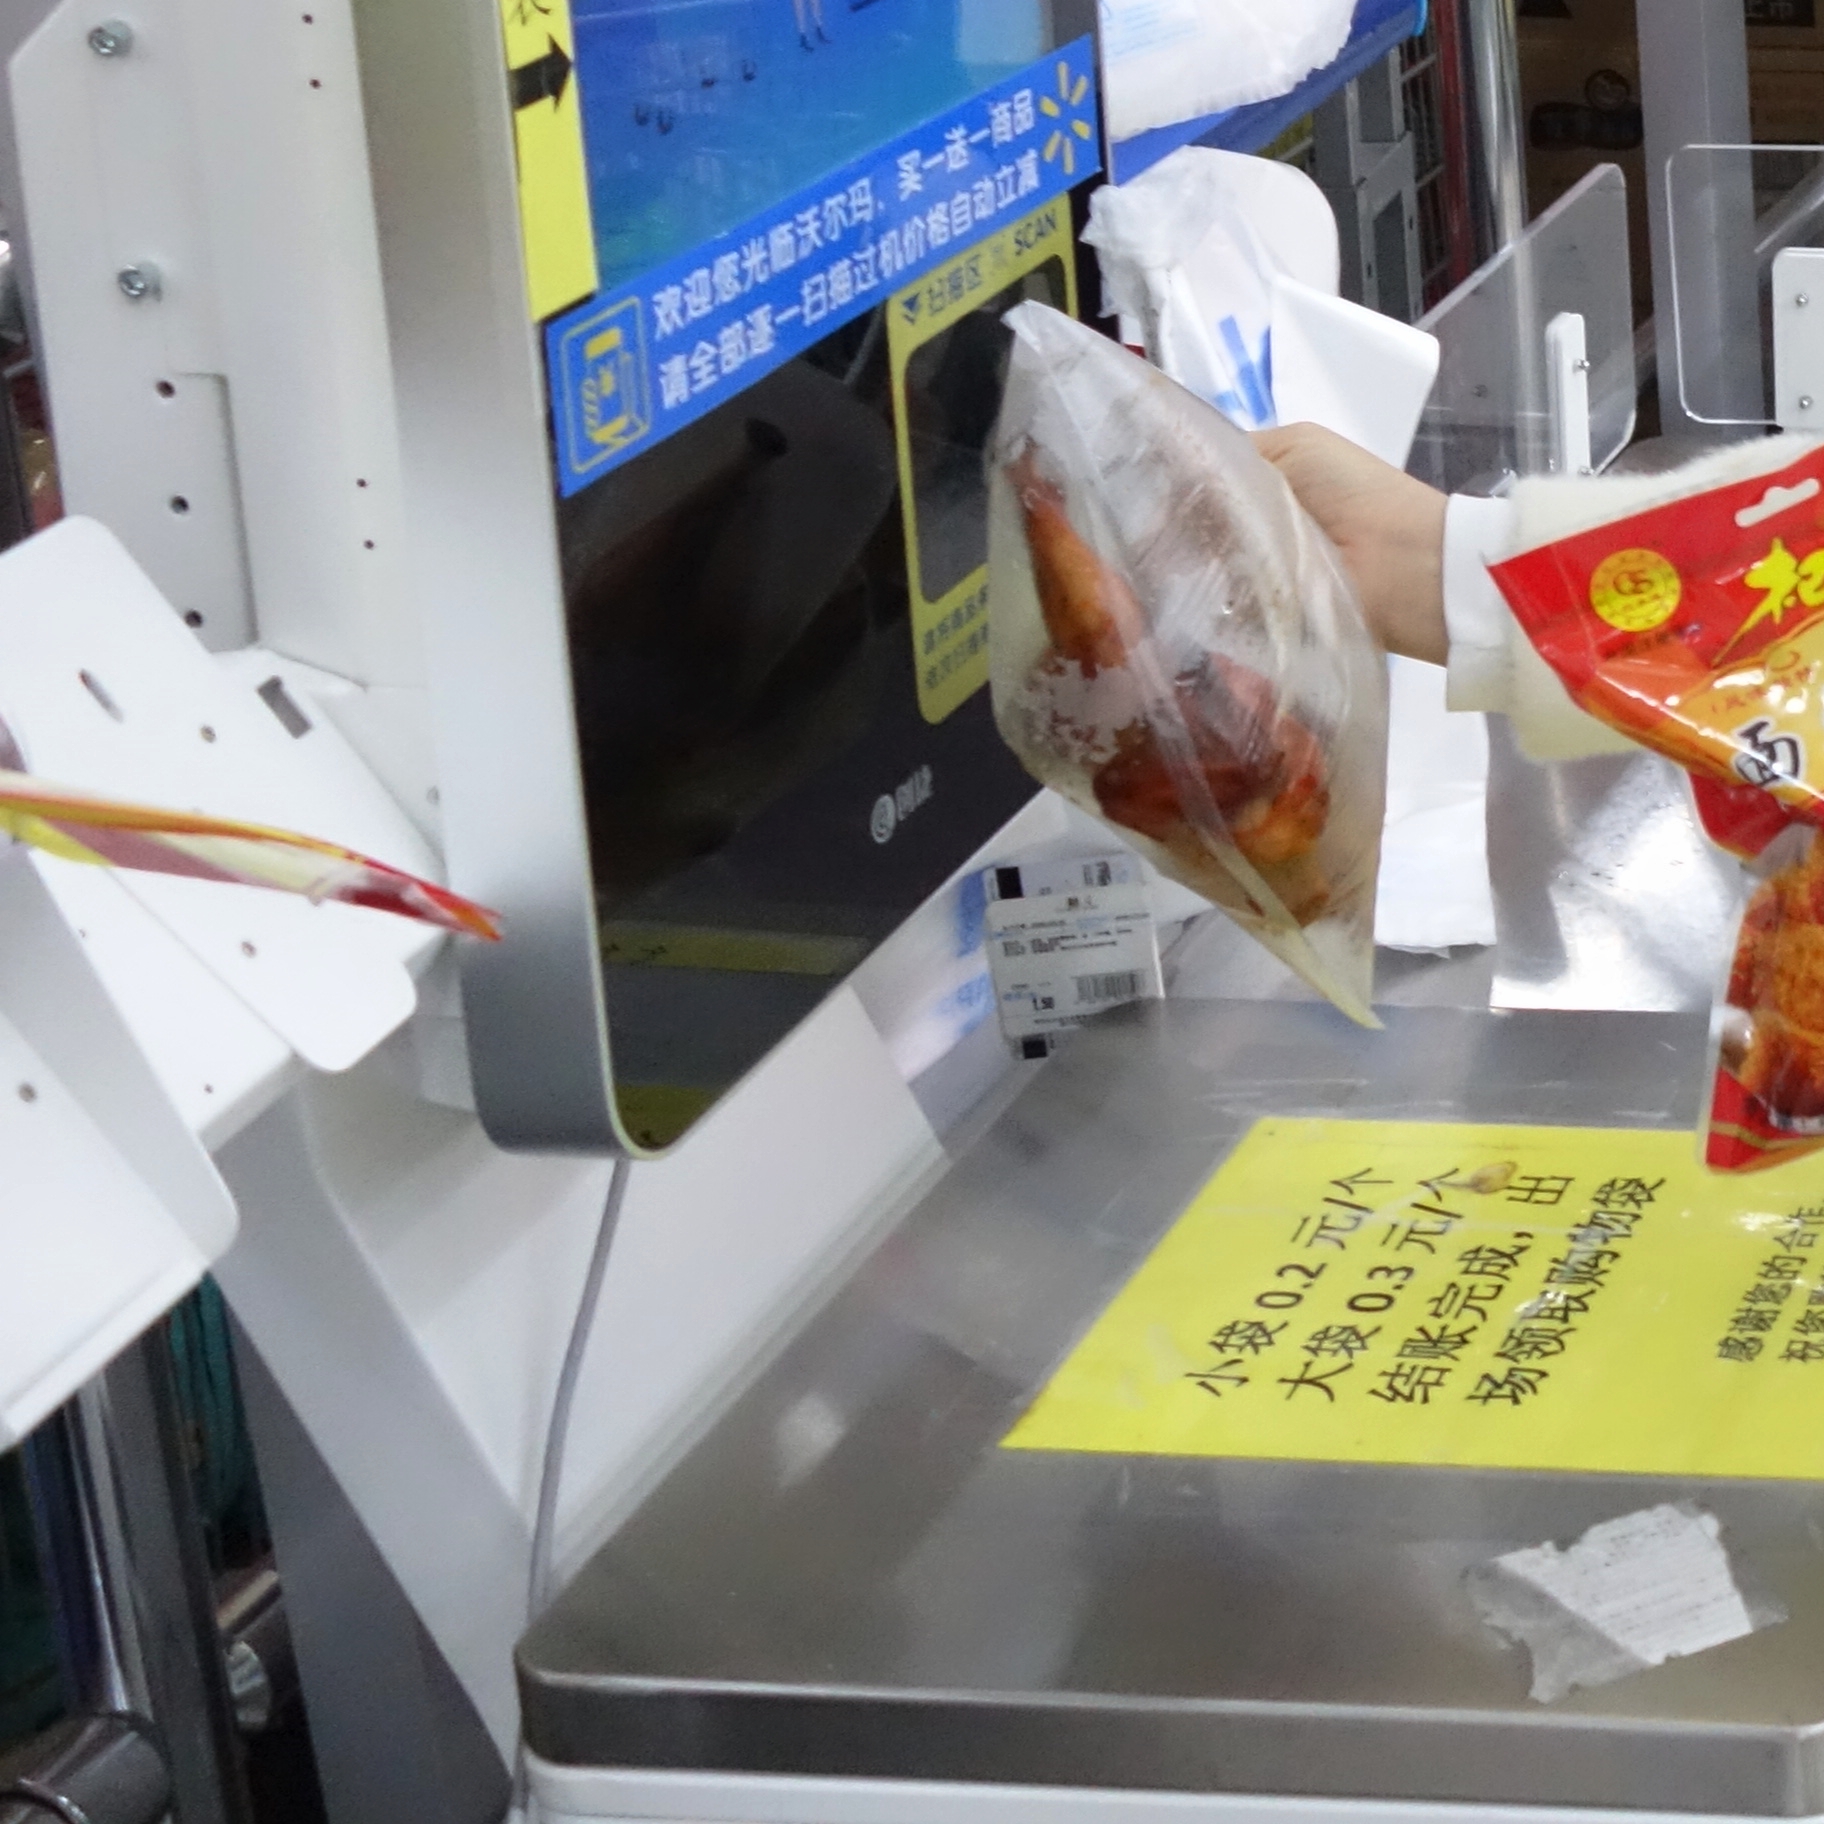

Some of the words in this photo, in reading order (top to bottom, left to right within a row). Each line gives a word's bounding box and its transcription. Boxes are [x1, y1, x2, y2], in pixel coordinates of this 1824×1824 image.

[658, 148, 1042, 410] 请全部逐一扫描过机价格自动立减
[1013, 208, 1060, 256] SCAN
[1465, 1176, 1667, 1407] 场领取购物袋
